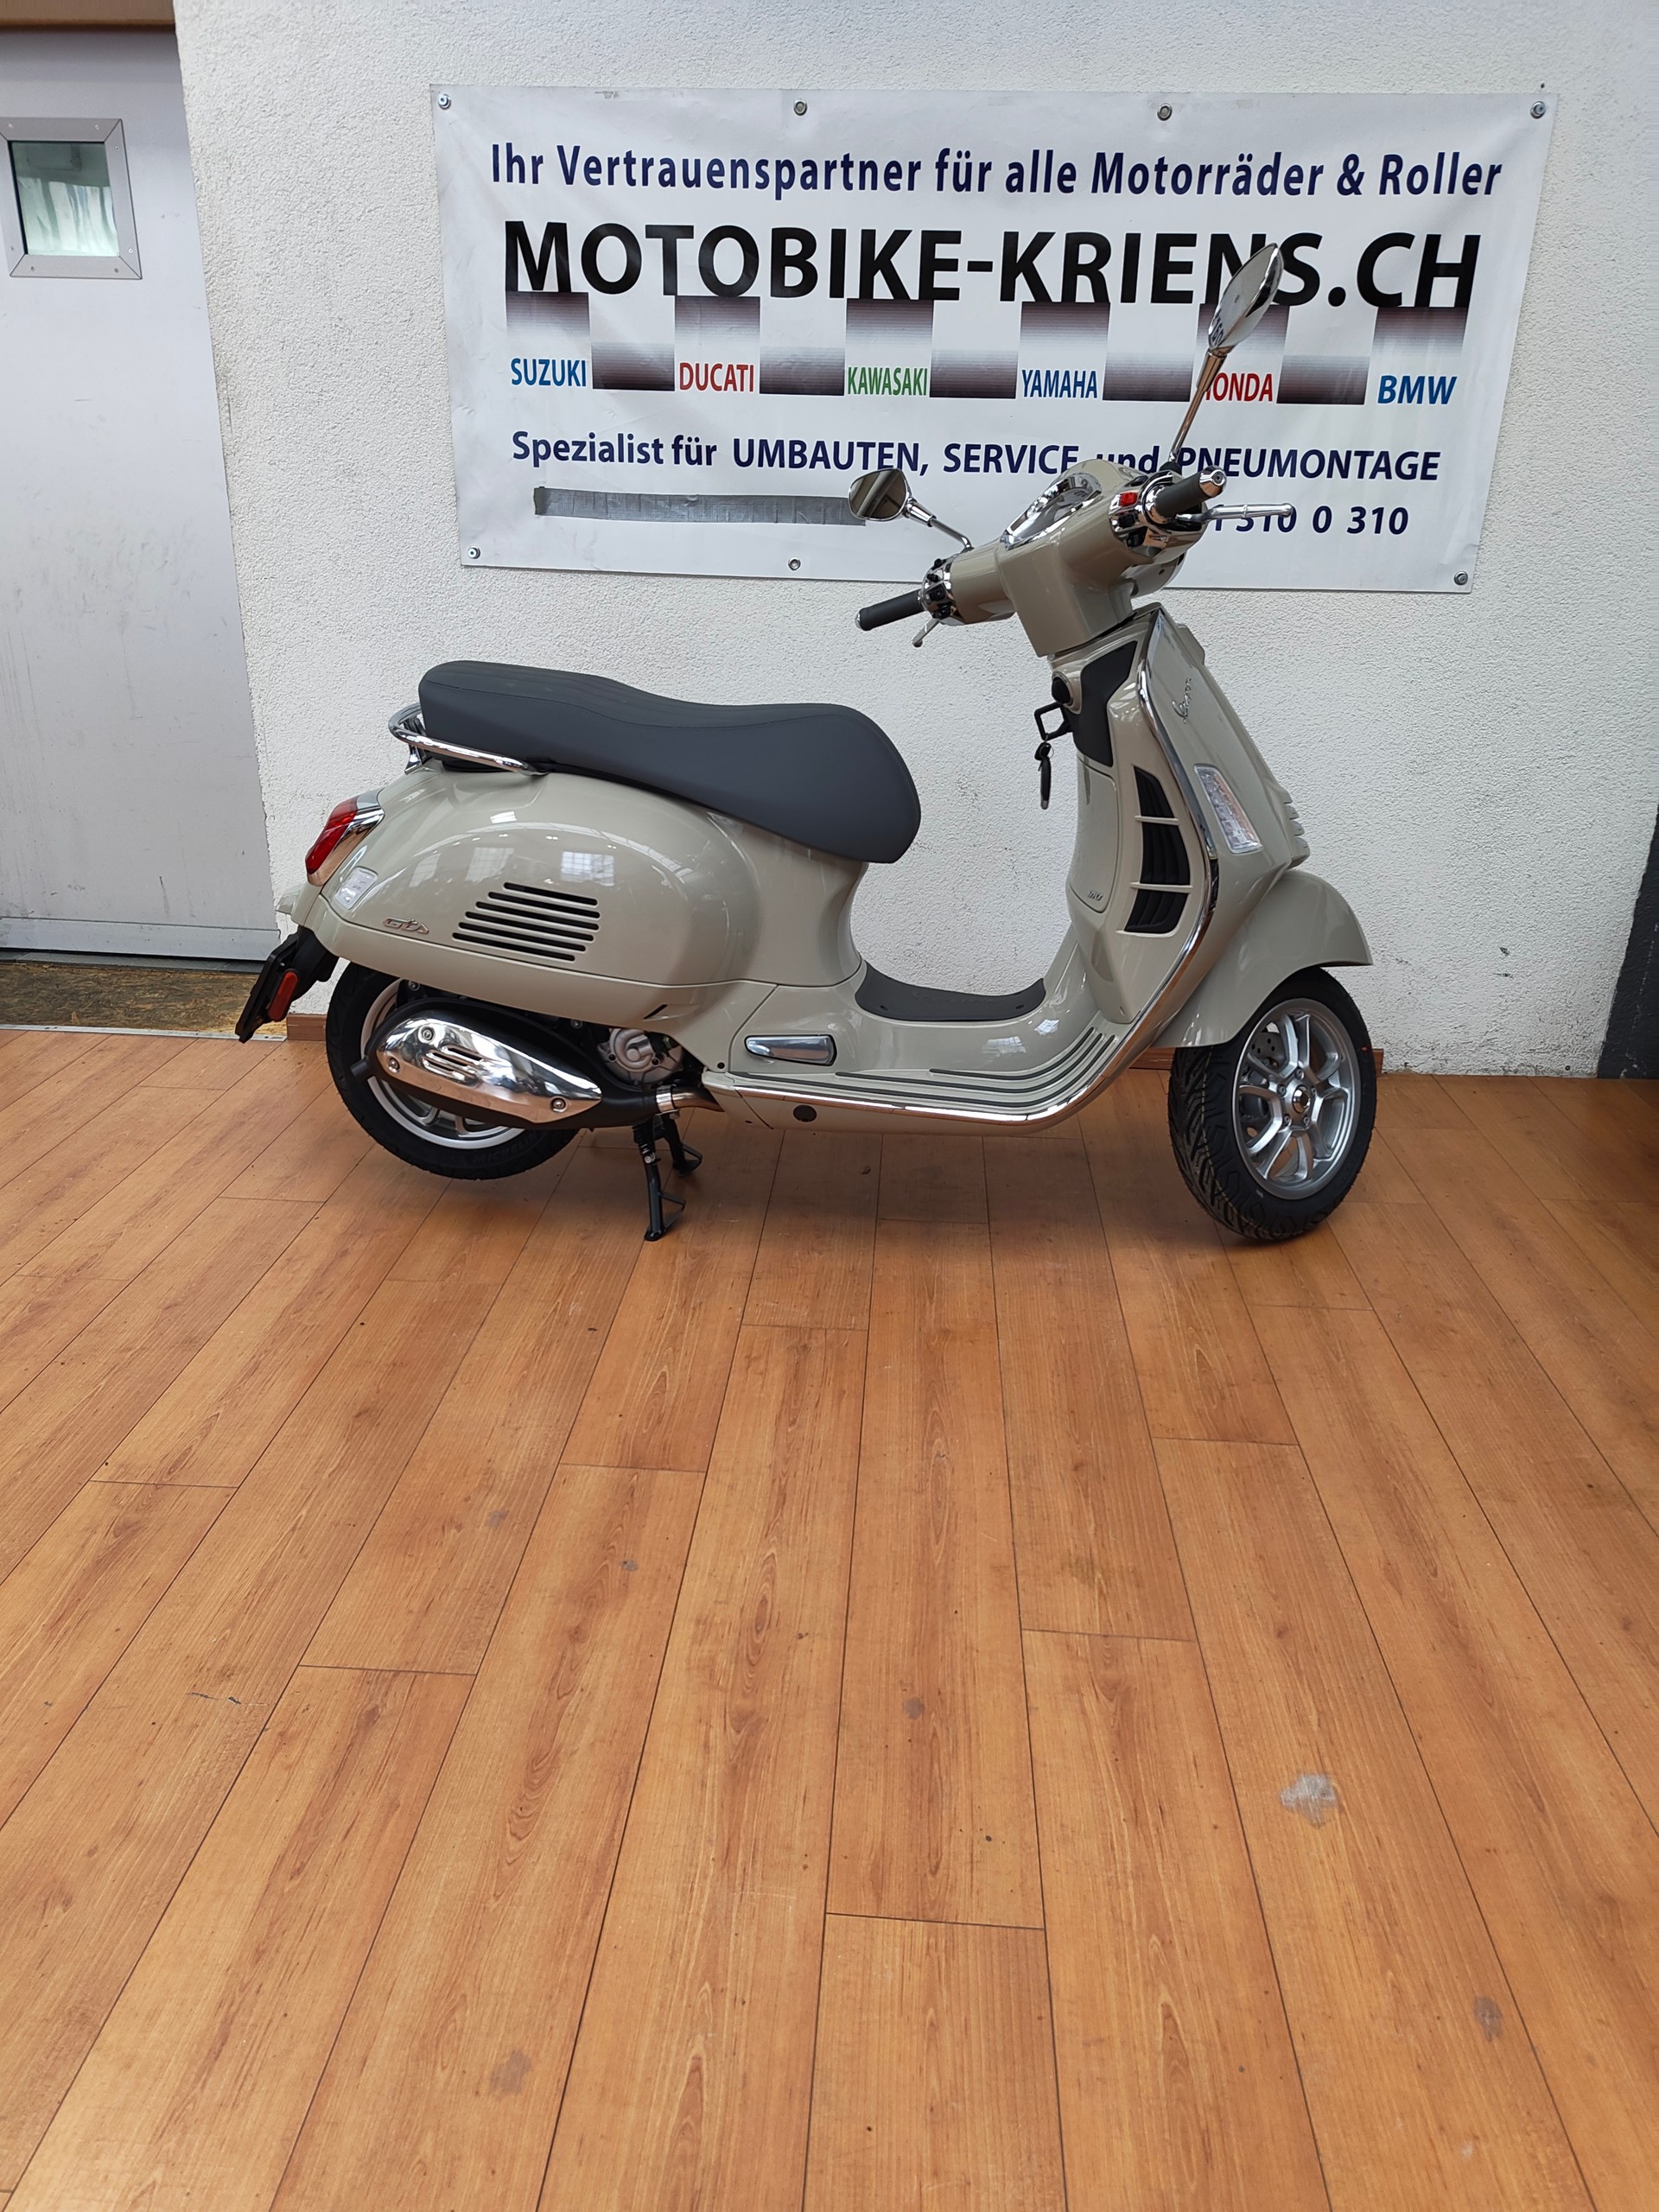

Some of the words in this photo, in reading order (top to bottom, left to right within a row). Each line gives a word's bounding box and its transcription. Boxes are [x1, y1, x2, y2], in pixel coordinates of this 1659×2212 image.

[492, 142, 543, 185] Ihr
[556, 144, 922, 201] Vertrauenspartner
[935, 147, 993, 193] für
[1005, 149, 1077, 194] alle
[1090, 151, 1325, 196] Motorräder
[1337, 153, 1365, 196] &
[1378, 151, 1503, 196] Roller
[505, 220, 1481, 308] MOTOBIKE-KRIENS.CH
[511, 358, 587, 387] SUZUKI
[679, 362, 754, 392] DUCATI
[848, 366, 928, 397] KAWASAKI
[1021, 369, 1098, 399] YAMAHA
[1205, 372, 1274, 403] ONDA
[1377, 374, 1458, 405] BMW
[512, 430, 664, 468] Spezialist
[671, 434, 717, 467] für
[733, 438, 929, 476] UMBAUTEN,
[943, 442, 1079, 475] SERVICE
[1176, 447, 1441, 481] PNEUMONTAGE
[1312, 505, 1332, 534] 0
[1346, 505, 1408, 536] 310
